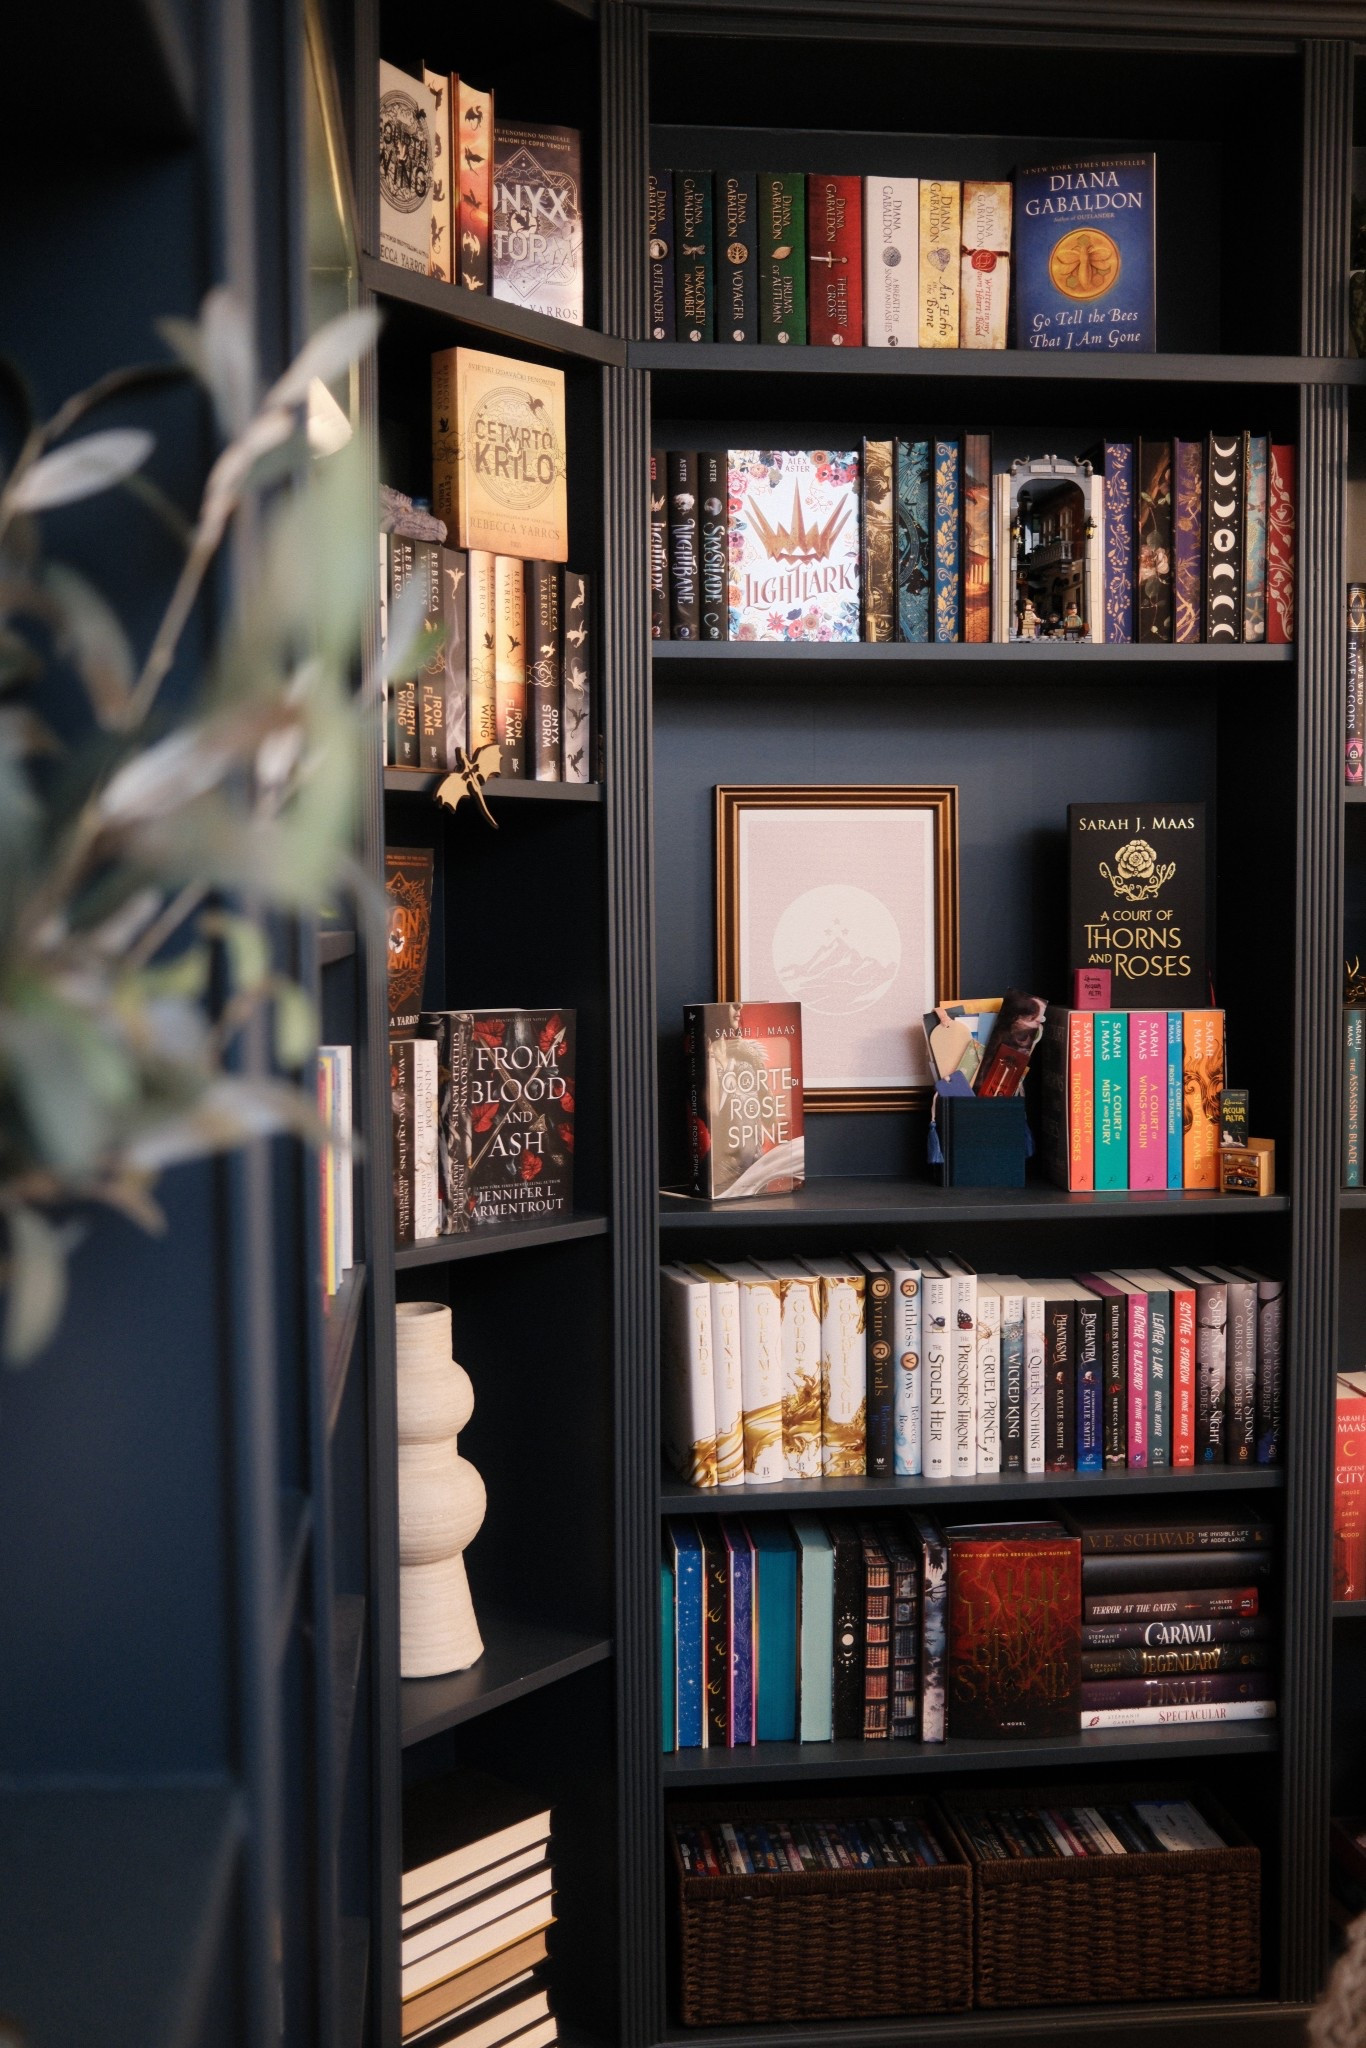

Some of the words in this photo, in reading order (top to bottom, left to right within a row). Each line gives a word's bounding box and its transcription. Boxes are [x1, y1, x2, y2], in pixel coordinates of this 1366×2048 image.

[1049, 170, 1120, 192] DIANA
[656, 191, 667, 223] DIANA
[684, 178, 695, 239] GABALDON
[694, 193, 704, 225] DIANA
[727, 178, 738, 239] GABALDON
[737, 193, 748, 225] DIANA
[771, 181, 782, 241] GABALDON
[782, 195, 793, 229] DIANA
[825, 183, 836, 243] GABALDON
[835, 198, 846, 231] DIANA
[882, 185, 893, 245] GABALDON
[892, 200, 902, 232] DIANA
[929, 182, 941, 245] GABALDON
[941, 196, 953, 234] DIANA
[1025, 192, 1143, 217] GABALDON
[985, 206, 993, 239] DIANA
[653, 263, 664, 323] OUTLANDER
[684, 283, 695, 318] AMBER
[694, 266, 706, 327] DRAGONFLY
[732, 270, 744, 321] VOYAGER
[772, 277, 782, 325] AUTUMN
[783, 276, 793, 315] DRUMS
[826, 284, 837, 318] CROSS
[837, 276, 847, 298] THE
[837, 299, 848, 328] FIERY
[1033, 312, 1051, 332] Go
[1054, 310, 1083, 326] Tell
[1088, 308, 1104, 324] the
[1107, 307, 1138, 323] Bees
[1029, 333, 1060, 349] That
[1079, 331, 1102, 345] Am
[1109, 330, 1141, 348] Gone
[475, 441, 554, 485] KRILO
[679, 458, 687, 483] ASTER
[709, 458, 717, 483] ASTER
[430, 552, 439, 614] REBECCA
[743, 562, 854, 615] LIGHTLARK
[540, 578, 549, 627] YARROS
[550, 575, 559, 633] REBECCA
[1347, 642, 1357, 675] HAVE
[1348, 678, 1355, 693] NO
[397, 690, 407, 727] WING
[405, 682, 416, 736] FOURTH
[423, 686, 435, 737] FLAME
[431, 695, 443, 729] IRON
[505, 699, 516, 747] FLAME
[514, 708, 523, 739] IRON
[1346, 694, 1356, 729] GODS
[542, 704, 551, 749] STORM
[551, 709, 560, 745] ONYX
[1079, 817, 1129, 831] SARAH
[1152, 816, 1195, 830] MAAS
[1113, 909, 1153, 922] COURT
[1156, 909, 1174, 921] OF
[1083, 923, 1182, 950] THORNS
[1088, 954, 1112, 964] AND
[1115, 953, 1192, 980] ROSES
[715, 1026, 751, 1038] SARAH
[767, 1024, 795, 1036] MAAS
[1072, 1030, 1081, 1060] MAAS
[1084, 1022, 1092, 1057] SARAH
[1101, 1030, 1110, 1061] MAAS
[1113, 1022, 1121, 1058] SARAH
[1139, 1029, 1147, 1060] MAAS
[1150, 1022, 1159, 1057] SARAH
[1194, 1028, 1203, 1060] MAAS
[1205, 1021, 1214, 1057] SARAH
[398, 1058, 406, 1084] WAR
[452, 1032, 460, 1082] GILDED
[476, 1045, 560, 1072] FROM
[460, 1057, 468, 1107] CROWN
[472, 1075, 567, 1105] BLOOD
[721, 1067, 792, 1094] CORTE
[792, 1078, 799, 1086] DI
[1072, 1072, 1081, 1110] THORNS
[1102, 1079, 1111, 1104] MIST
[1139, 1075, 1148, 1108] WINGS
[452, 1085, 460, 1127] BONES
[503, 1111, 533, 1125] AND
[730, 1095, 787, 1121] ROSE
[1084, 1100, 1092, 1136] COURT
[1113, 1095, 1122, 1131] COURT
[1150, 1094, 1159, 1131] COURT
[1193, 1092, 1202, 1132] SILVER
[1349, 1073, 1358, 1130] ASSASSIN'S
[488, 1131, 545, 1158] ASH
[728, 1121, 789, 1149] SPINE
[1073, 1128, 1081, 1162] ROSES
[1102, 1118, 1111, 1145] FURY
[1139, 1124, 1148, 1149] RUIN
[1193, 1135, 1202, 1170] FLAMES
[1349, 1133, 1358, 1165] BLADE
[470, 1198, 564, 1218] ARMENTROUT
[478, 1188, 545, 1204] JENNIFER
[1133, 1305, 1145, 1340] BUTCHER
[1152, 1312, 1165, 1346] LEATHER
[1178, 1301, 1192, 1336] SCYTHE
[1080, 1308, 1097, 1369] ENCHANTRA
[1235, 1315, 1243, 1357] CARISSA
[928, 1351, 944, 1405] STOLEN
[957, 1344, 973, 1406] PRISONER'S
[983, 1355, 996, 1397] CRUEL
[1007, 1353, 1021, 1403] WICKED
[1028, 1355, 1042, 1395] QUEEN
[1132, 1349, 1144, 1391] BLACKBIRD
[1152, 1355, 1164, 1379] LARK
[1178, 1347, 1190, 1385] SPARROW
[1209, 1368, 1220, 1403] WINGS
[1234, 1361, 1243, 1421] BROADBENT
[1263, 1358, 1271, 1419] BROADBENT
[1056, 1389, 1064, 1420] KAYLIE
[930, 1409, 946, 1441] HEIR
[955, 1407, 972, 1450] THRONE
[981, 1401, 997, 1444] PRINCE
[1006, 1406, 1020, 1438] KING
[1030, 1402, 1042, 1449] NOTHING
[1056, 1421, 1064, 1449] SMITH
[1209, 1410, 1223, 1445] NIGHT
[1244, 1406, 1254, 1444] STONE
[1337, 1423, 1366, 1433] MAAS
[1336, 1473, 1364, 1484] CITY
[1123, 1531, 1195, 1547] SCHWAB
[1092, 1605, 1121, 1616] TERROR
[1153, 1602, 1178, 1613] GATES
[1144, 1621, 1216, 1647] CARAVAL
[1142, 1648, 1222, 1674] LEGENDARY
[1158, 1707, 1227, 1728] SPECTACULAR
